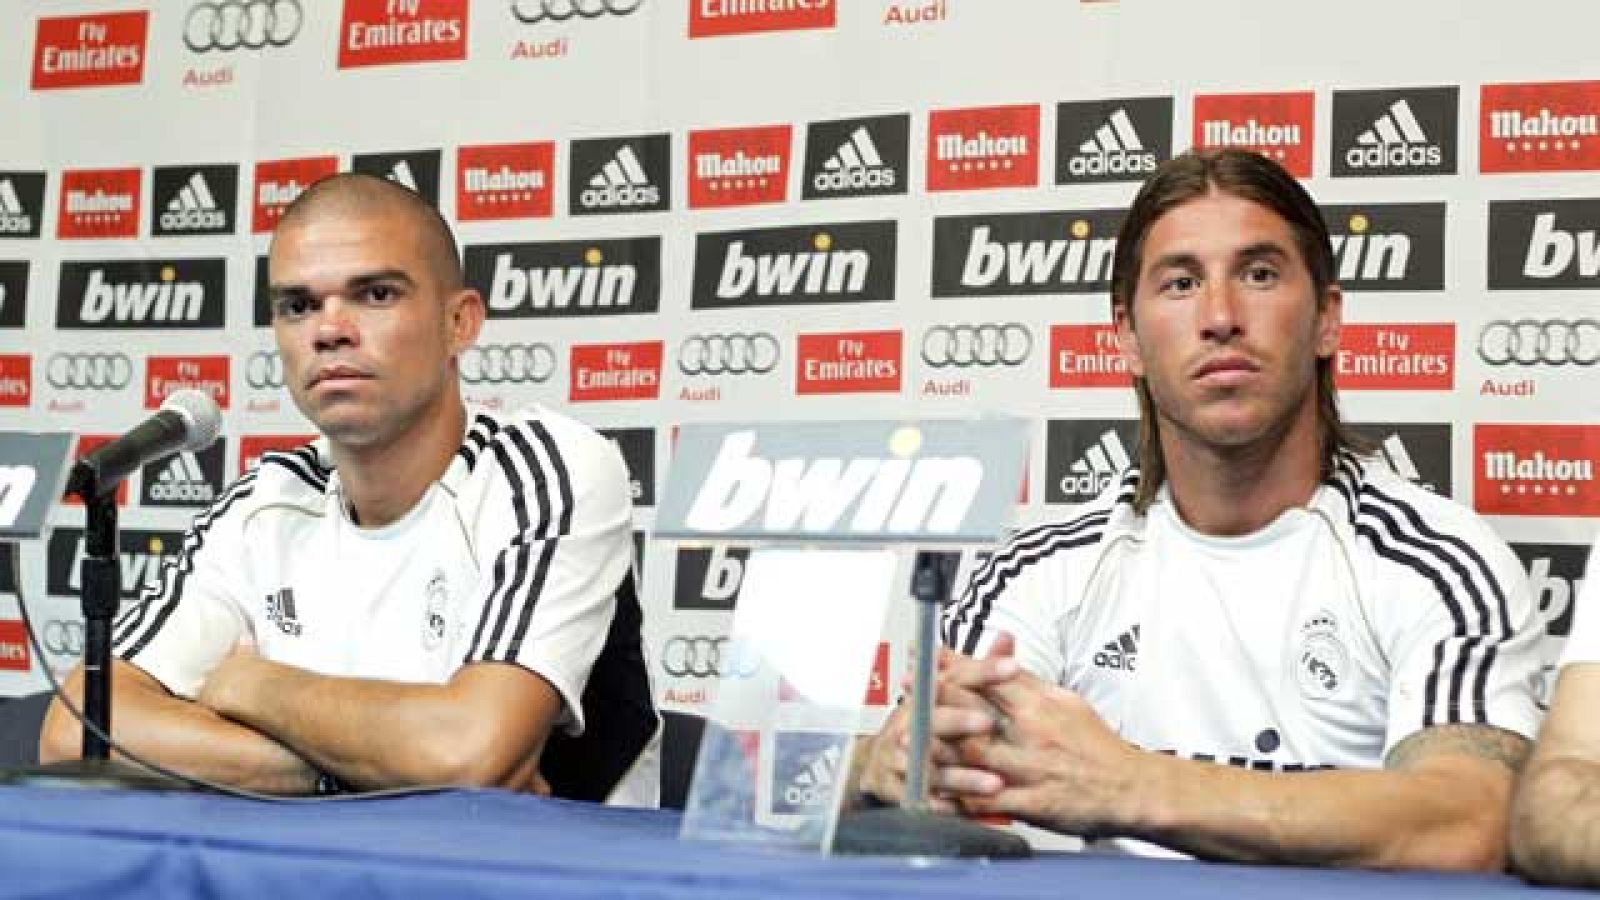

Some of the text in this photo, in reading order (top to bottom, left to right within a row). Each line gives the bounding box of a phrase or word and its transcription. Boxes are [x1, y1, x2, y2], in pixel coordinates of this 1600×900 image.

[883, 0, 947, 25] Audi
[79, 22, 107, 42] Fly
[349, 19, 461, 50] Emirates
[42, 43, 140, 73] Emirates
[511, 39, 568, 59] Audi
[182, 67, 233, 86] Audi
[1202, 119, 1300, 146] Mahou
[1490, 108, 1598, 138] Mahou
[936, 130, 1027, 161] Mahou
[1345, 142, 1441, 167] adidas
[696, 151, 781, 178] Mahou
[1069, 150, 1157, 176] adidas
[465, 166, 545, 191] Mahou
[814, 168, 896, 191] adidas
[259, 180, 305, 206] Mah
[580, 185, 660, 208] adidas
[160, 207, 226, 229] adidas
[716, 232, 870, 298] bwin
[961, 220, 1118, 287] bwin
[488, 248, 636, 310] bwin
[79, 265, 205, 322] bwin
[839, 339, 864, 357] Fly
[1377, 330, 1410, 351] Fly
[804, 358, 897, 381] Emirates
[1059, 351, 1129, 375] Emira
[1338, 351, 1448, 375] Emirates
[577, 368, 656, 389] Emirates
[924, 379, 970, 395] Audi
[1480, 379, 1535, 396] Audi
[680, 386, 720, 402] Audi
[1484, 450, 1594, 481] Mahou
[685, 425, 983, 532] bwin
